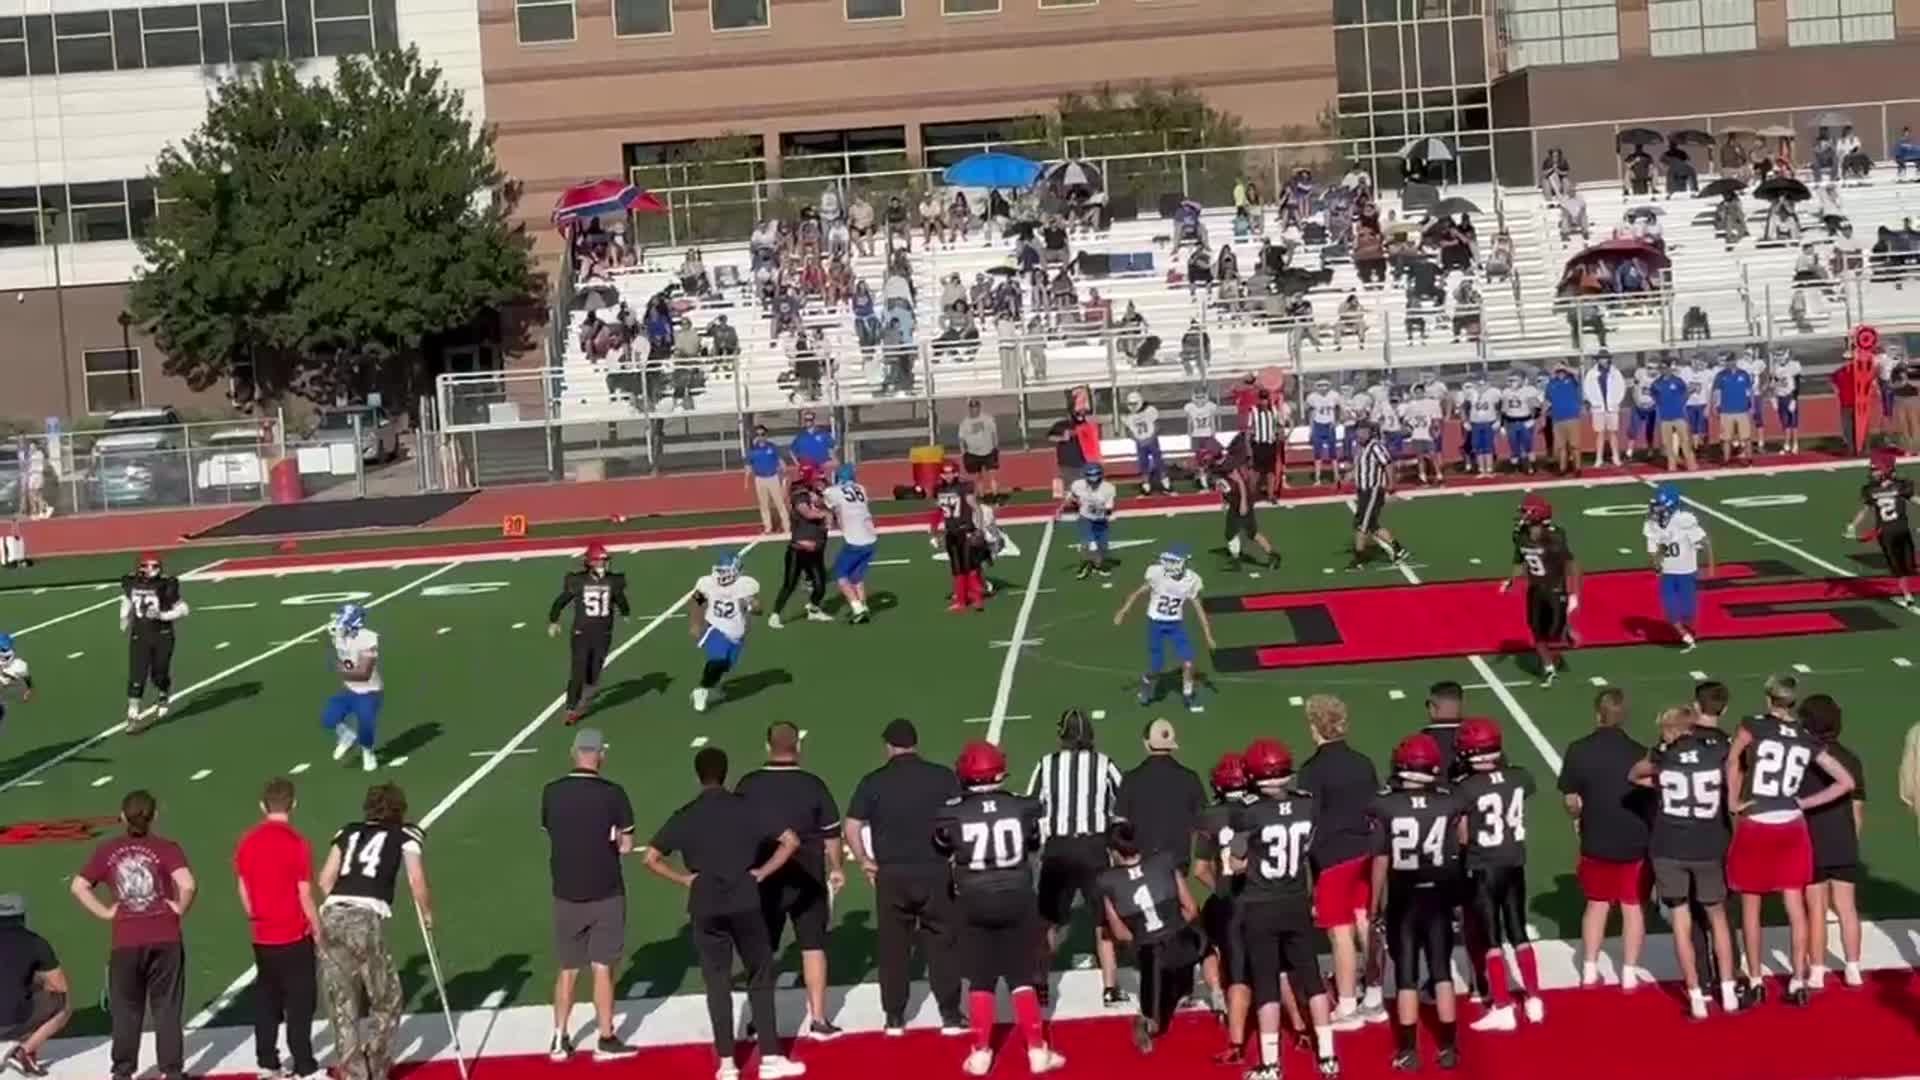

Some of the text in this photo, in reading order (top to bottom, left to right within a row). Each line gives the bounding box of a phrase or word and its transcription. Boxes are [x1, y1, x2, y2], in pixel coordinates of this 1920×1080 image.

[1877, 498, 1898, 521] 2
[583, 590, 610, 617] 51
[713, 600, 737, 619] 52
[1157, 595, 1182, 616] 22
[1752, 739, 1811, 797] 26
[1477, 786, 1525, 848] 34
[1659, 769, 1721, 819] 25
[340, 830, 388, 878] 14
[962, 818, 1024, 870] 70
[1391, 815, 1448, 870] 24
[1133, 884, 1164, 932] 1
